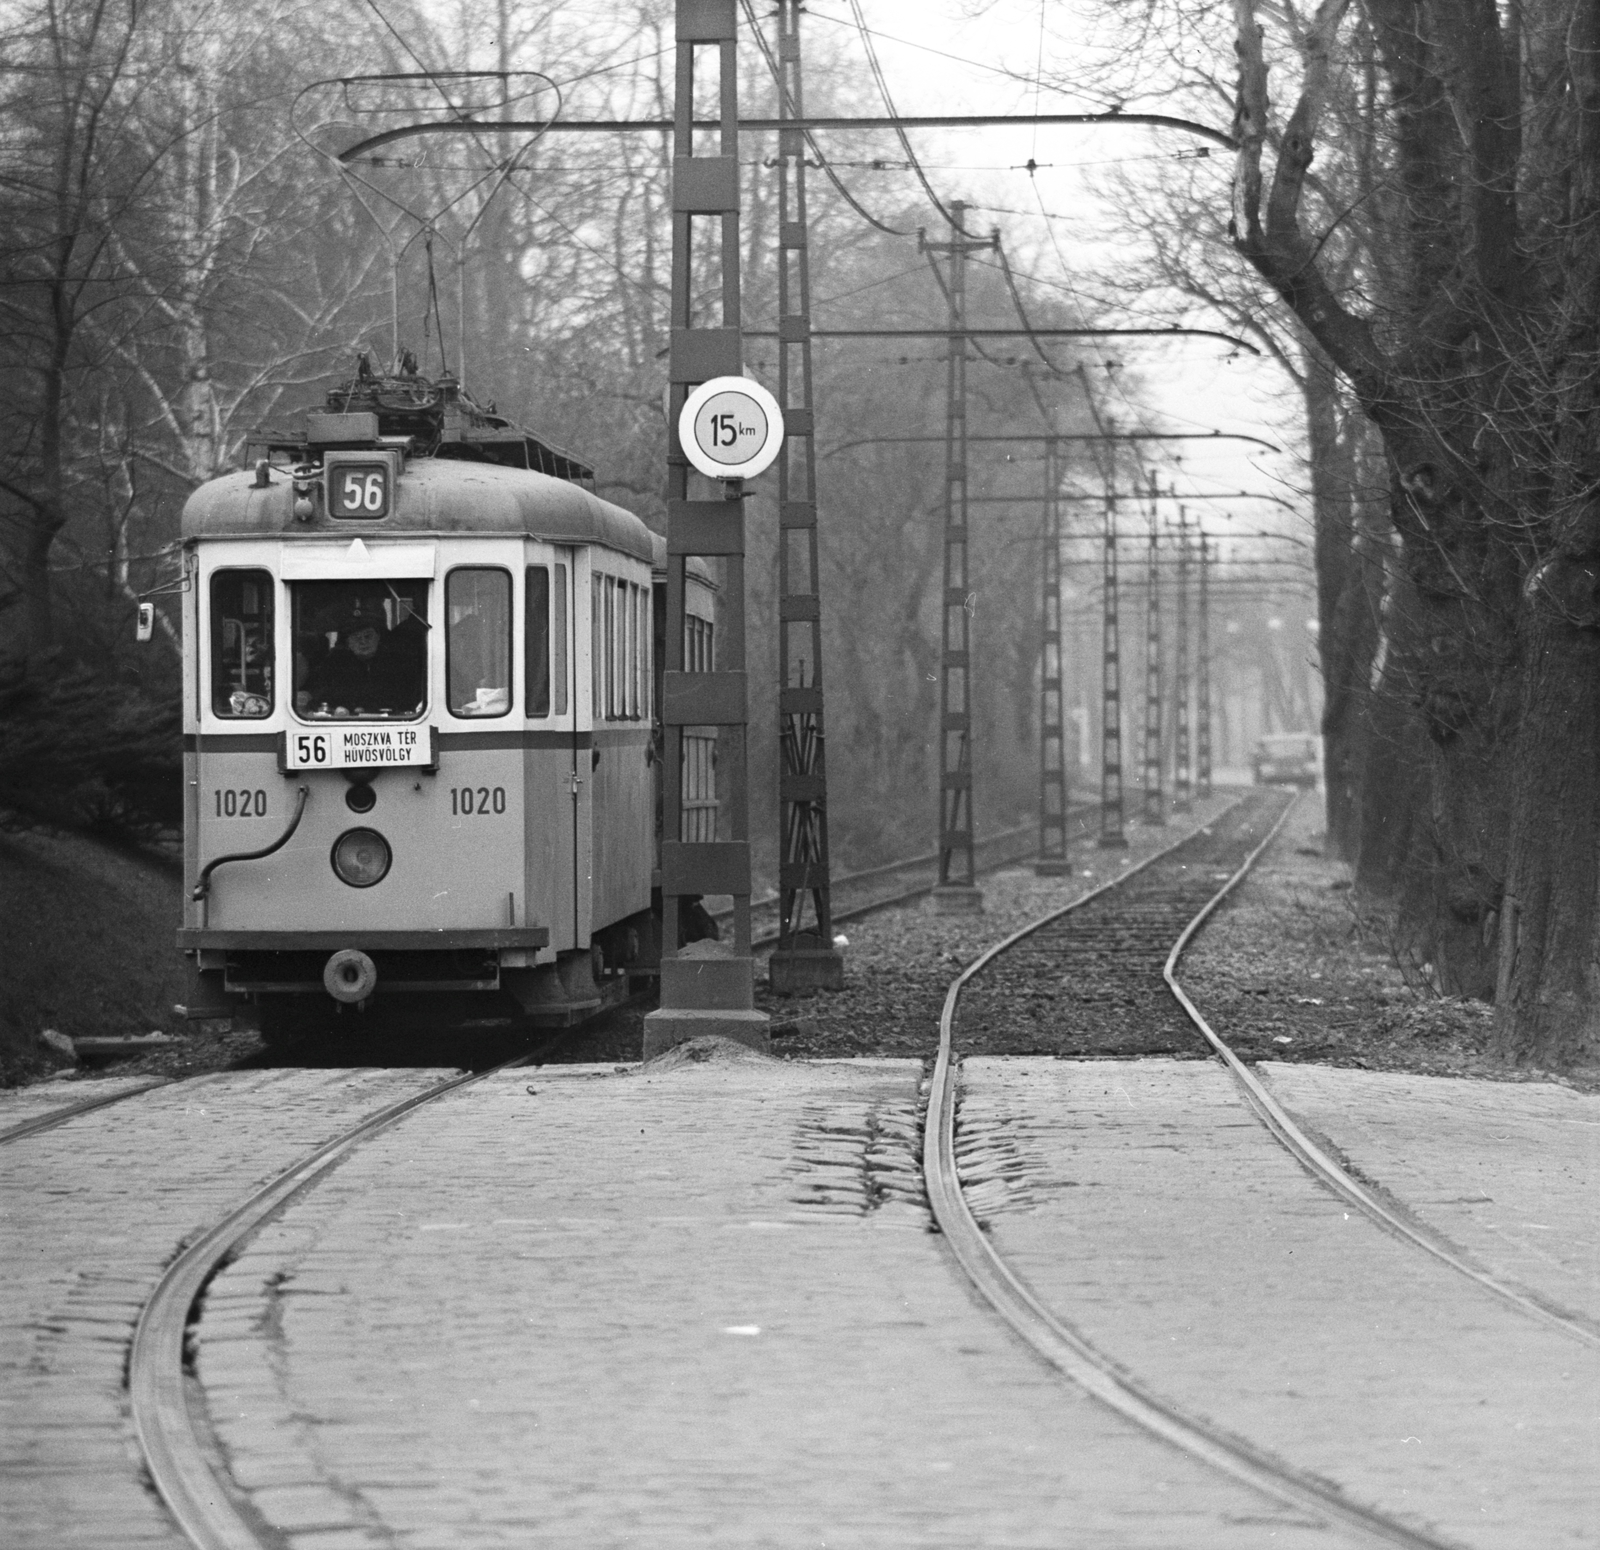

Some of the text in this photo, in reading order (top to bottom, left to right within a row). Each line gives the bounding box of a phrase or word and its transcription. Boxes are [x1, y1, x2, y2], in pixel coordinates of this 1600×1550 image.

[343, 473, 383, 510] 56
[298, 736, 326, 763] 56
[343, 729, 417, 747] MOSZKVA TÉR
[215, 789, 267, 817] 1020
[451, 787, 506, 815] 1020
